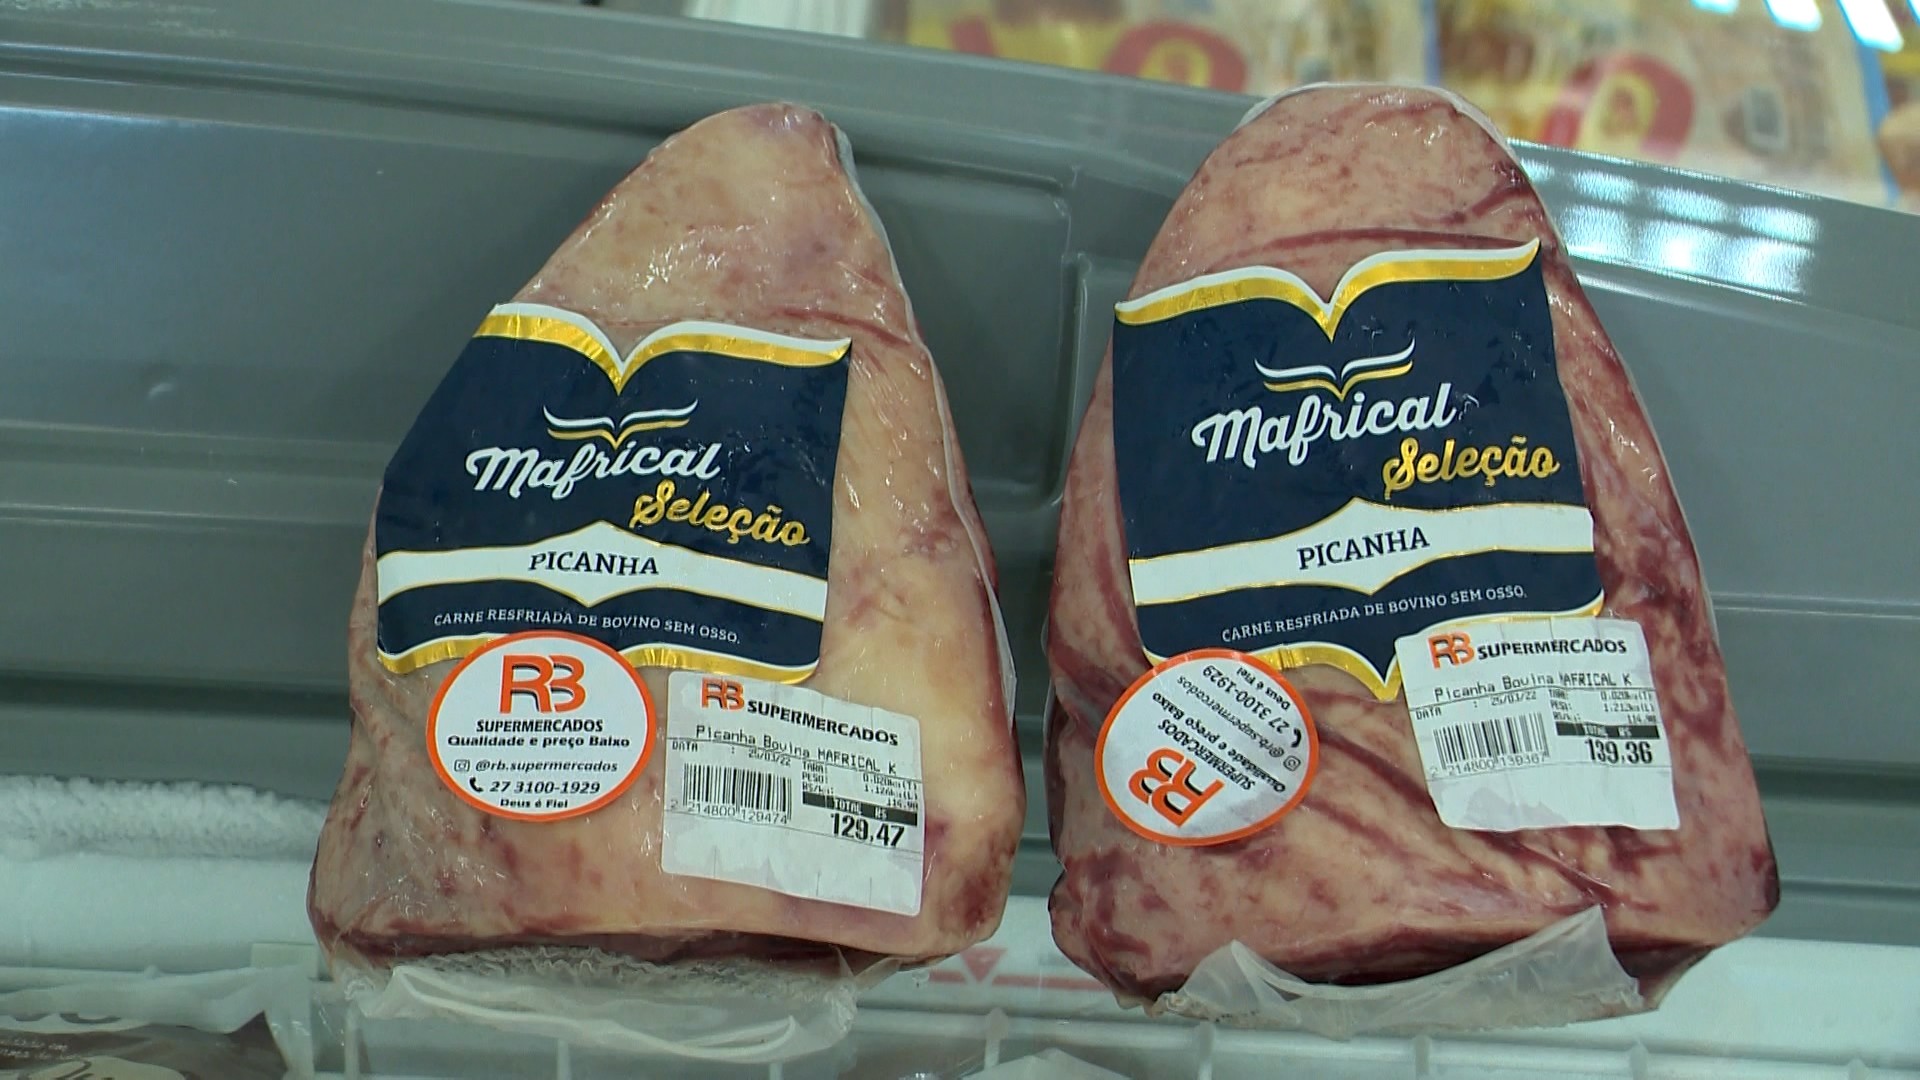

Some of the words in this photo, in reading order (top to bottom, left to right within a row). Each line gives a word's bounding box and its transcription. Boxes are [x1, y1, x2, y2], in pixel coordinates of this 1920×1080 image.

[1192, 383, 1459, 469] Mafrical
[466, 439, 721, 499] Mafrical
[1382, 436, 1560, 499] Seleção
[629, 480, 810, 547] Seleção
[1297, 527, 1430, 570] PICANHA
[528, 551, 659, 576] PICANHA
[434, 611, 483, 627] CARNE
[487, 608, 573, 626] RESFRIADA
[578, 614, 597, 628] DE
[602, 615, 660, 631] BOVINO
[664, 620, 694, 636] SEM
[699, 626, 740, 644] OSSO.
[1222, 621, 1273, 642] CARNE
[1275, 606, 1360, 633] RESFRIADA
[1363, 602, 1386, 617] DE
[1389, 594, 1447, 615] BOVINO
[1451, 588, 1481, 604] SEM
[1485, 585, 1527, 600] OSSO.
[1427, 630, 1475, 669] RB
[1477, 639, 1627, 660] SUPERMERCADOS
[499, 654, 587, 714] RB
[1237, 667, 1256, 685] Fiel
[1256, 680, 1265, 689] é
[1434, 682, 1495, 702] Picanha
[1502, 673, 1554, 690] Bovina
[1623, 673, 1632, 686] K
[1153, 692, 1185, 720] Baixo
[1203, 665, 1272, 720] 3100-1929
[1266, 687, 1291, 711] Deus
[476, 719, 603, 733] SUPERMERCADOS
[702, 678, 744, 710] RB
[747, 699, 898, 746] SUPERMERCADOS
[1177, 676, 1284, 758] @rb.supermercados
[1268, 717, 1289, 735] 27
[1415, 706, 1442, 720] DATA
[448, 735, 524, 747] Qualidade
[529, 737, 538, 746] e
[542, 736, 584, 749] preço
[589, 736, 630, 747] Baixo
[1185, 717, 1221, 744] preço
[672, 741, 698, 752] DATA
[696, 725, 756, 745] Picanha
[763, 735, 810, 758] Bovina
[817, 747, 880, 772] MAFRICAL
[888, 760, 897, 775] K
[1158, 718, 1257, 790] SUPERMERCADOS
[1218, 741, 1226, 751] e
[476, 759, 618, 773] @rb.supermercados
[1228, 750, 1286, 793] Qualidade
[489, 781, 511, 793] 27
[514, 781, 601, 794] 3100-1929
[1128, 747, 1225, 828] RB
[500, 798, 531, 808] Deus
[534, 798, 542, 808] é
[546, 798, 568, 809] Fiel
[688, 801, 735, 817] 214800
